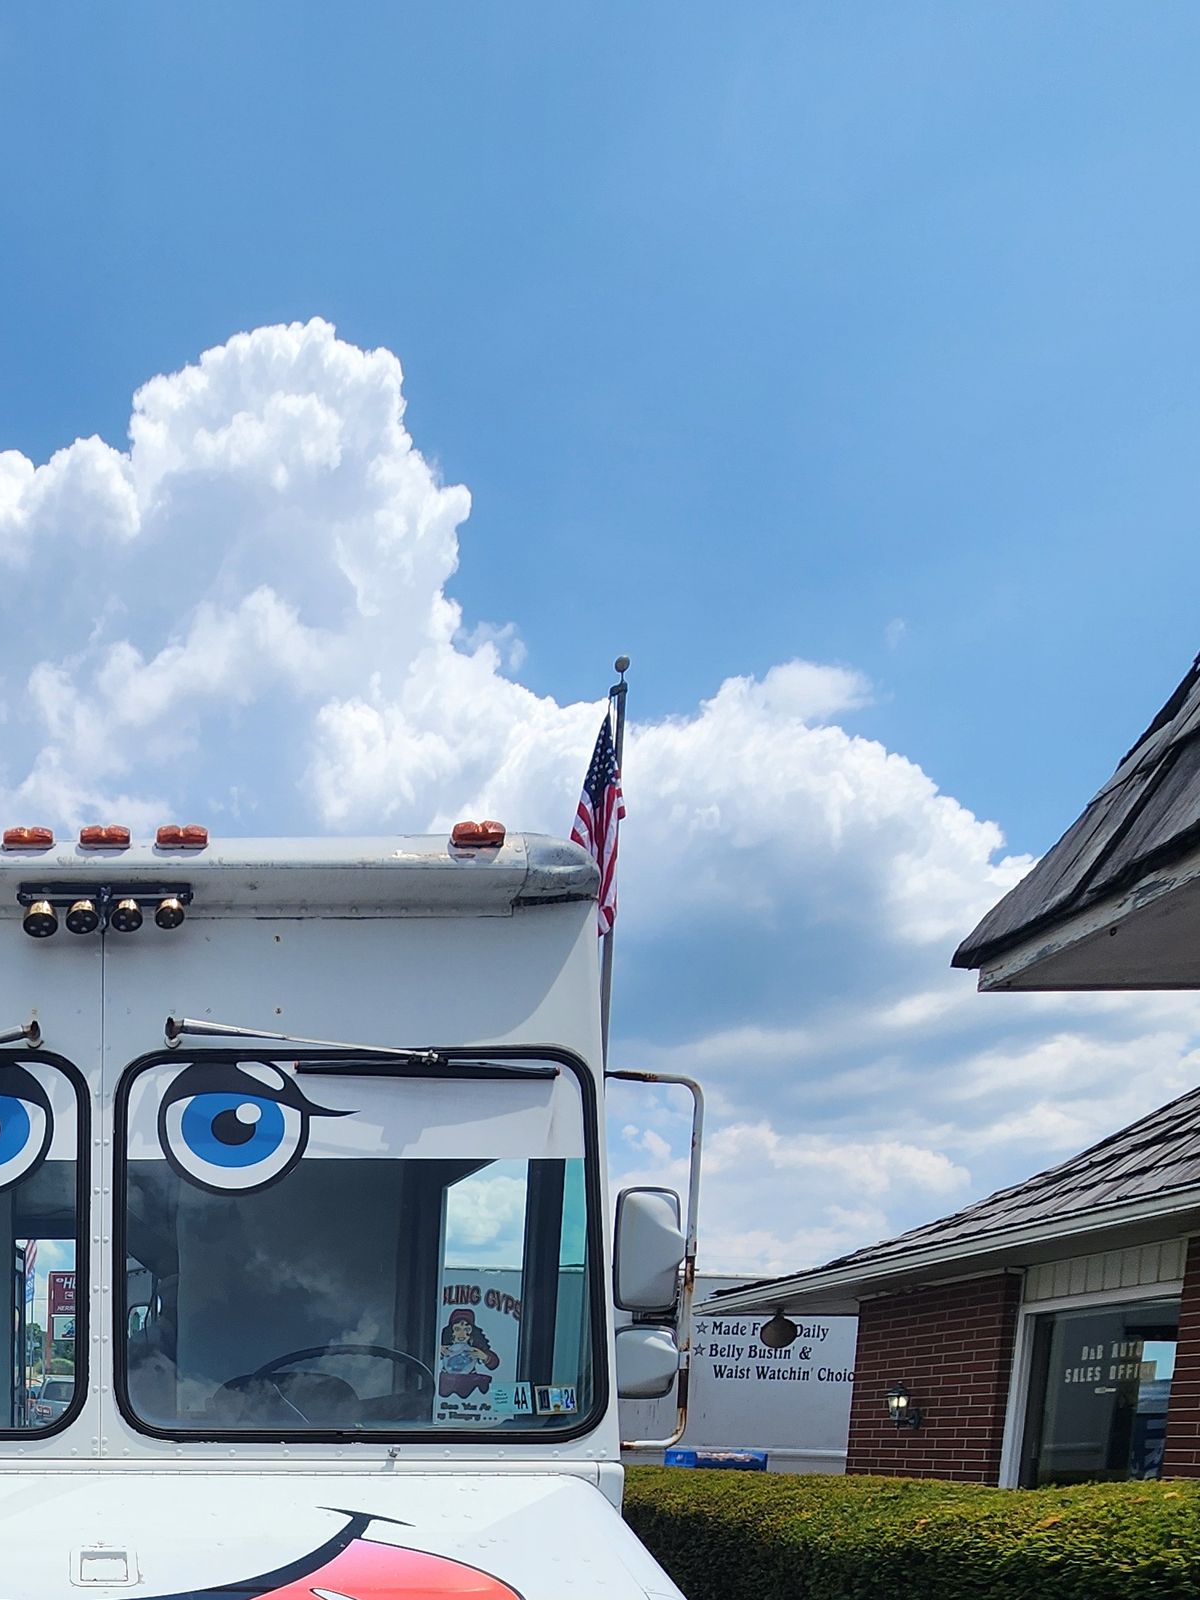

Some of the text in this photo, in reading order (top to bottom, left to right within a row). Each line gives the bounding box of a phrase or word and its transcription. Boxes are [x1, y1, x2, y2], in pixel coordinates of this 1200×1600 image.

[711, 1321, 747, 1336] Made
[795, 1323, 830, 1342] Daily
[708, 1343, 813, 1361] Belly Bustin' &
[1111, 1341, 1143, 1358] AUTO
[713, 1365, 751, 1380] Waist
[755, 1365, 813, 1381] Watchin'
[1064, 1363, 1154, 1384] SALES OFFI
[513, 1386, 529, 1410] 4A
[564, 1388, 576, 1410] 24
